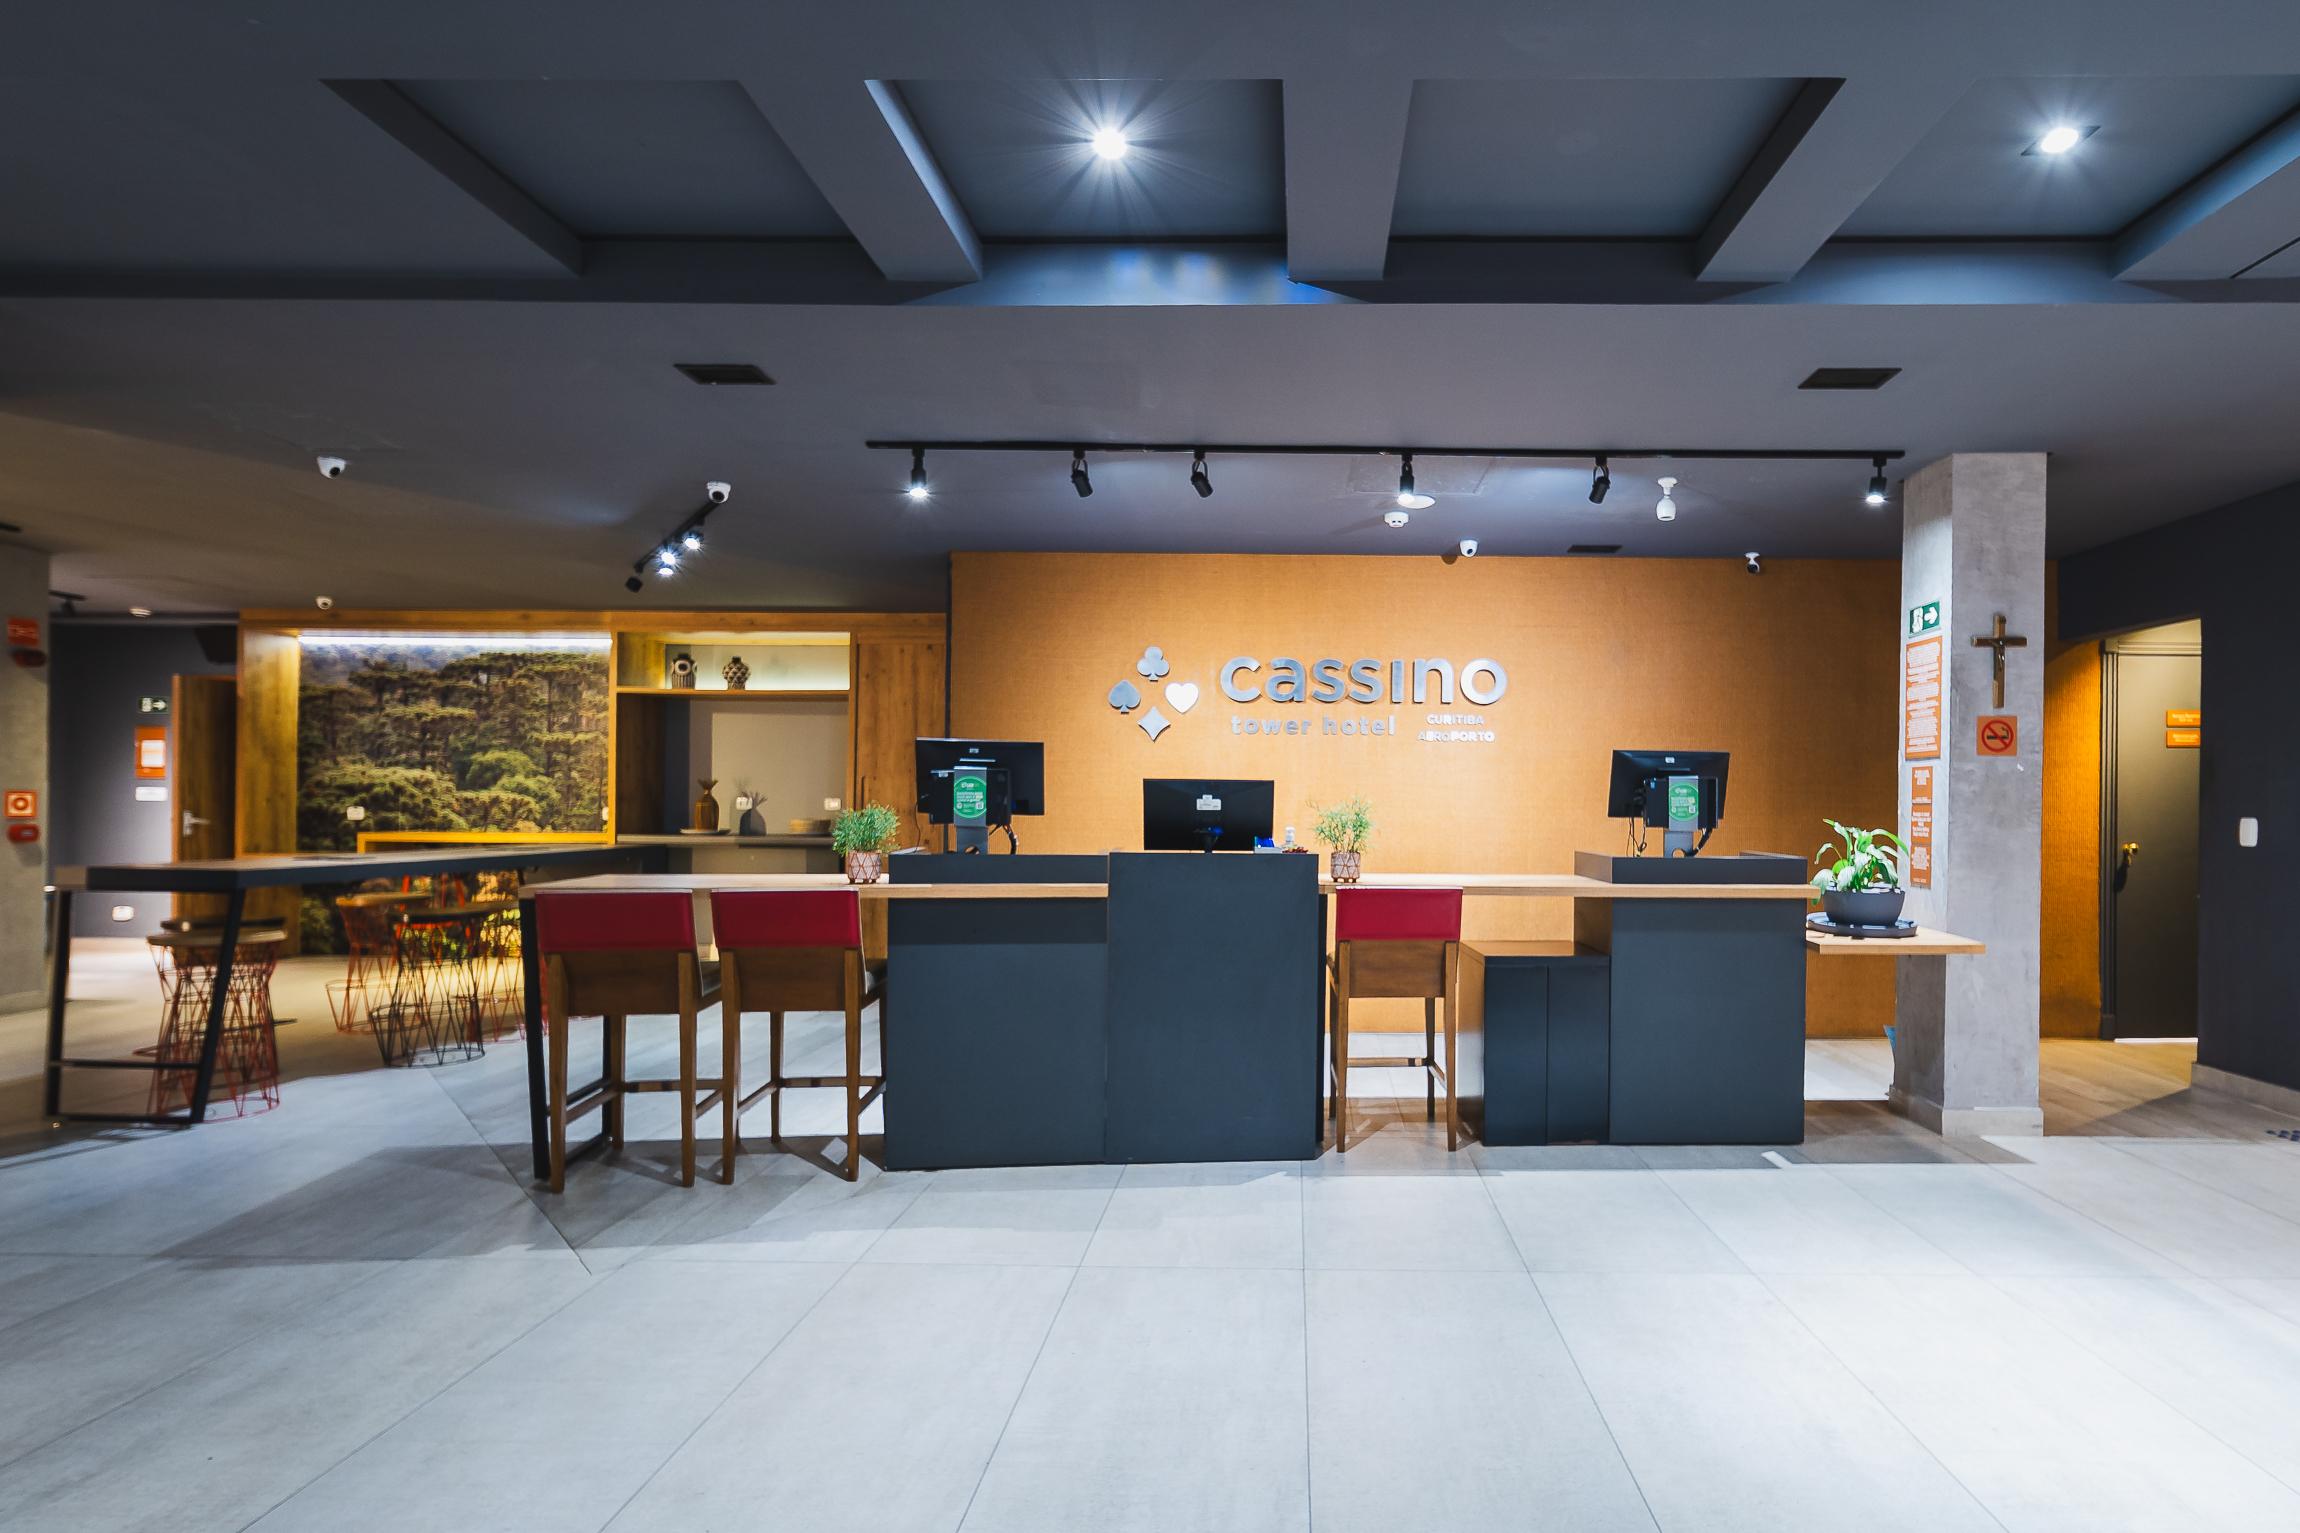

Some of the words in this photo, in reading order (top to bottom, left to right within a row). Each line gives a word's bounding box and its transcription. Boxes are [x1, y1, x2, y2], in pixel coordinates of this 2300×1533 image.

[1220, 656, 1508, 704] cassino
[1231, 715, 1312, 735] tower
[1322, 714, 1396, 735] hotel
[1426, 713, 1485, 725] CURITIBA
[1418, 730, 1496, 742] AEROPORTO
